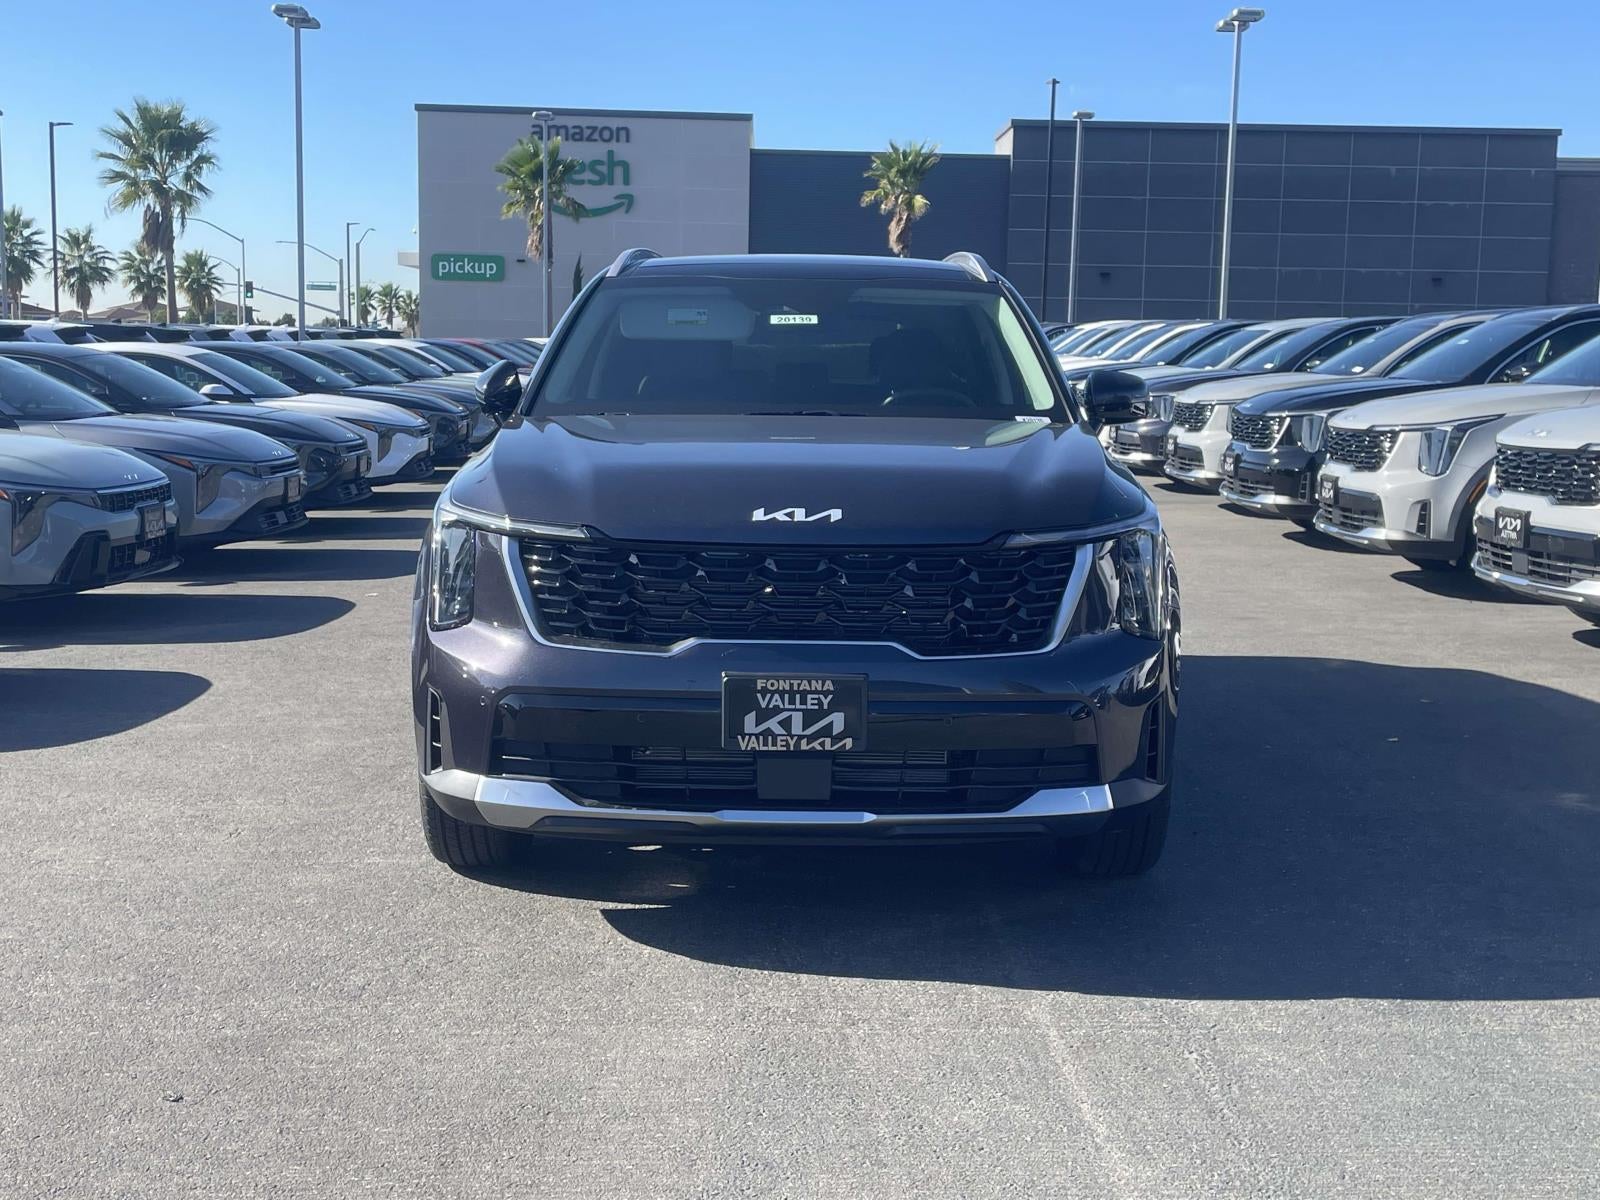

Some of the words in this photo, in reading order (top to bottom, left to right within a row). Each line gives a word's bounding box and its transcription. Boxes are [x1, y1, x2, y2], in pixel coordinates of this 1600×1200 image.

[531, 124, 630, 143] amazon
[563, 149, 630, 186] esh
[438, 257, 497, 278] pickup
[752, 507, 842, 522] KIA
[756, 679, 834, 691] FONTANA
[756, 693, 833, 710] VALLEY
[744, 710, 845, 736] KIA
[737, 735, 798, 751] VALLEY
[801, 737, 853, 751] KIA
